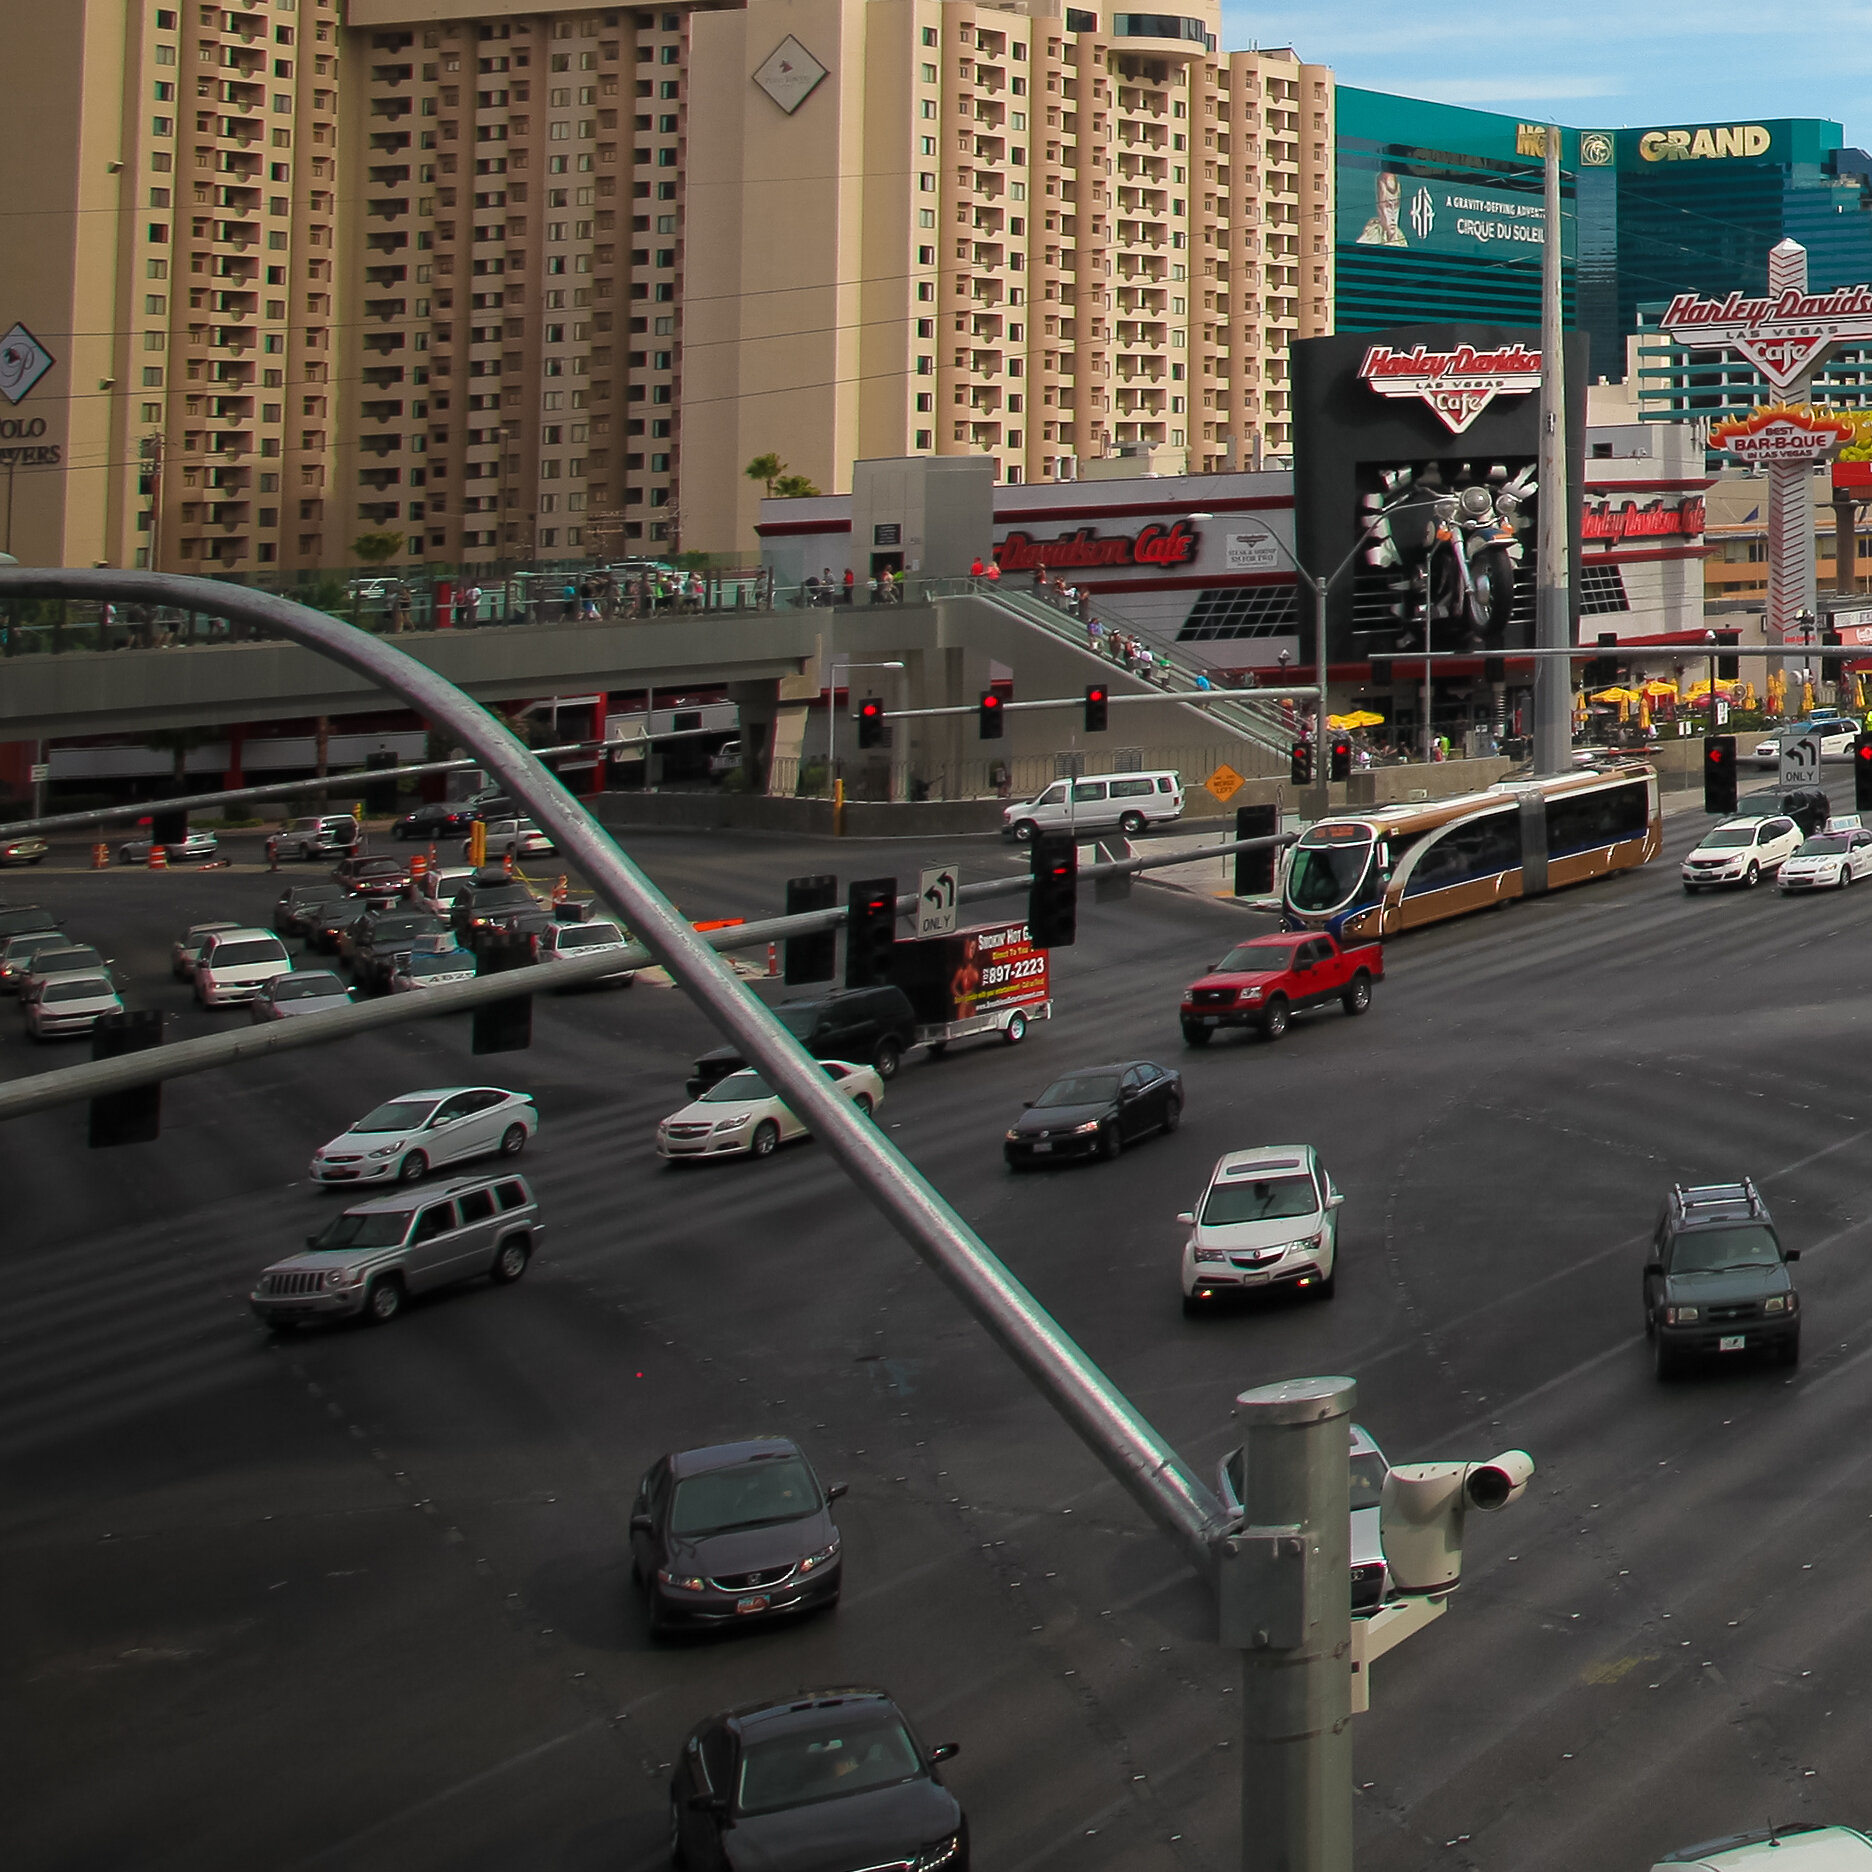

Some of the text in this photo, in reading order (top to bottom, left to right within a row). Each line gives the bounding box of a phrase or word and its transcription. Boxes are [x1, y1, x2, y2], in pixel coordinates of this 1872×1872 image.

[1639, 125, 1771, 162] GRAND
[1446, 196, 1452, 207] A
[1456, 218, 1545, 243] CIRQUE DU SOLEIL
[1727, 326, 1839, 339] LAS VEGAS
[1751, 341, 1809, 374] Cafe
[1436, 393, 1482, 420] Cafe
[1765, 428, 1794, 436] BEST
[1734, 435, 1826, 451] BAR-B-QUE
[1779, 450, 1812, 458] VEGAS
[1134, 523, 1195, 566] Cafe
[1786, 771, 1815, 781] ONLY
[923, 916, 950, 931] ONLY
[990, 957, 1044, 984] 897-2223
